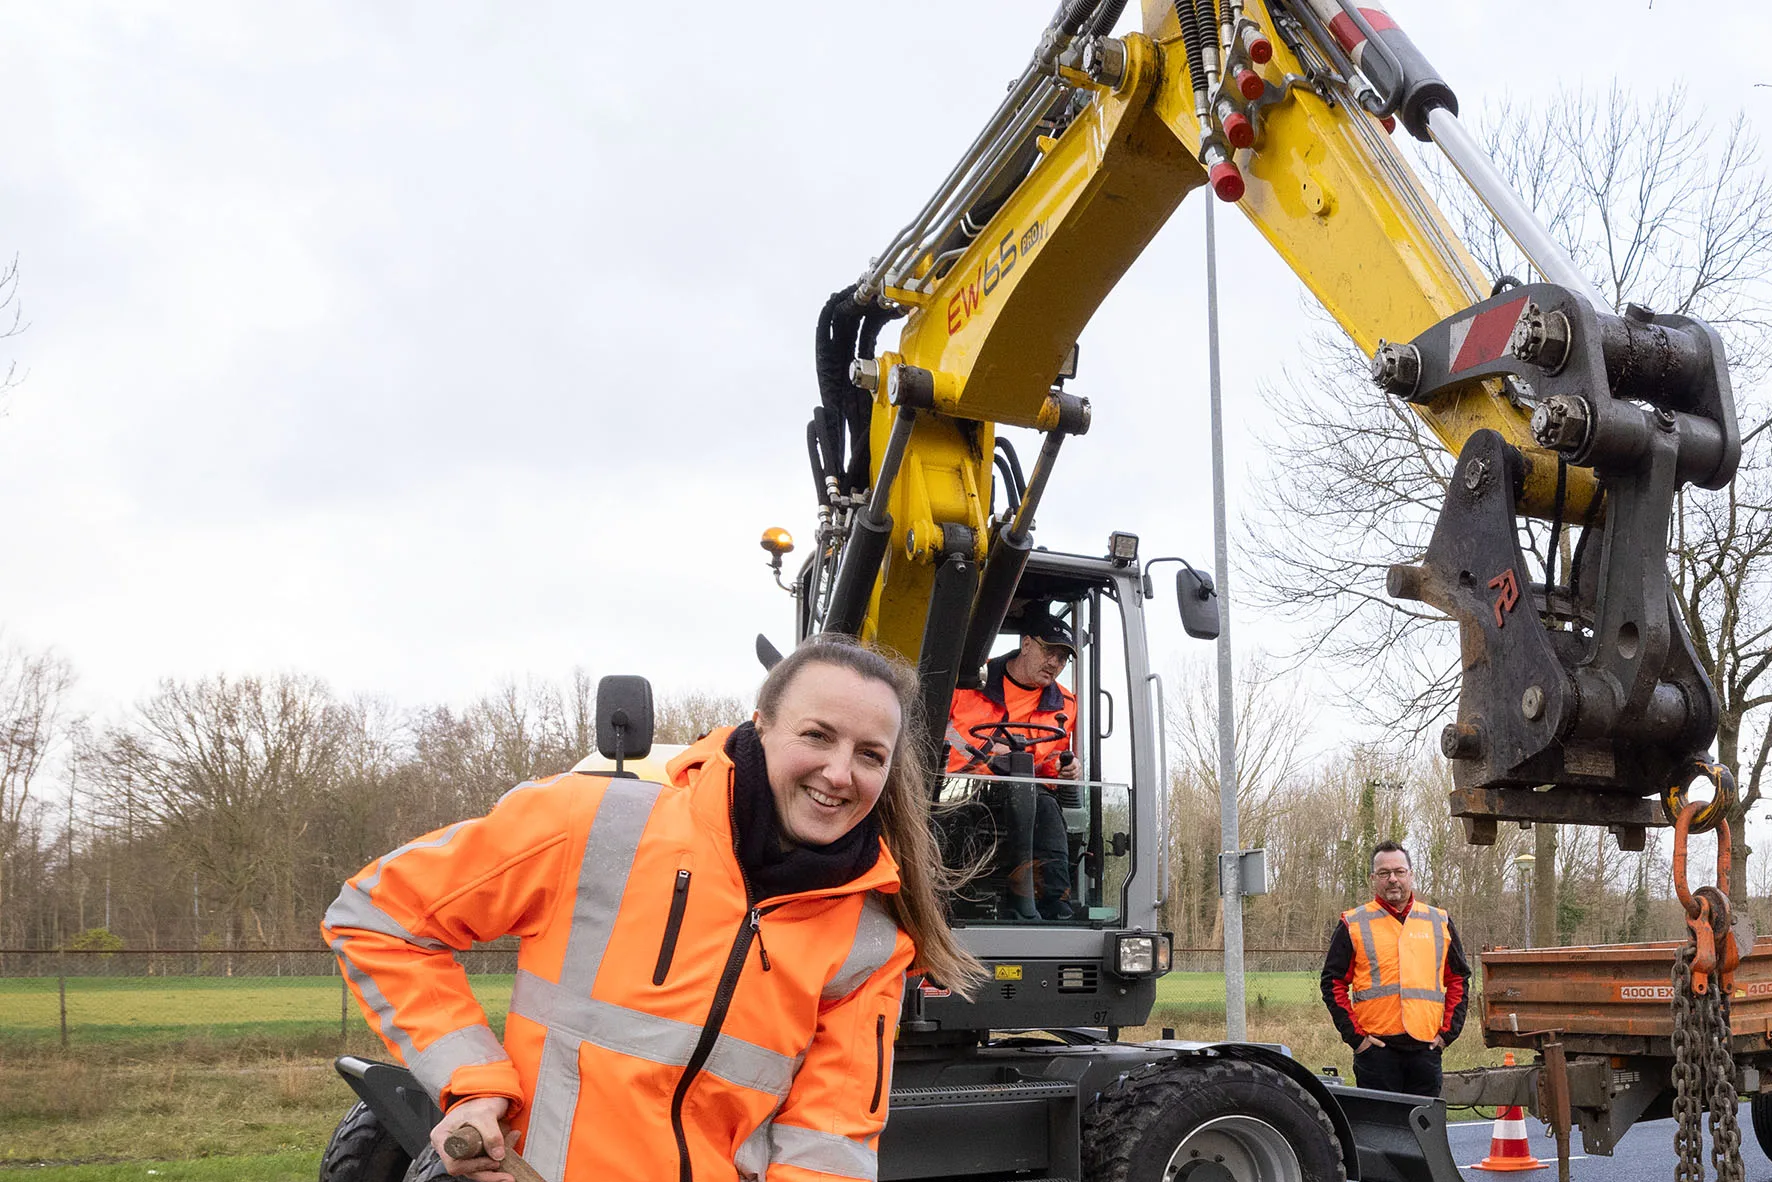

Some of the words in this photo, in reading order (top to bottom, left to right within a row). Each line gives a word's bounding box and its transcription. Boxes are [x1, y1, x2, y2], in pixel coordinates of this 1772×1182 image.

[948, 228, 1017, 336] EW65
[1622, 987, 1654, 998] 4000
[1657, 987, 1674, 997] EX
[1094, 1011, 1107, 1024] 97
